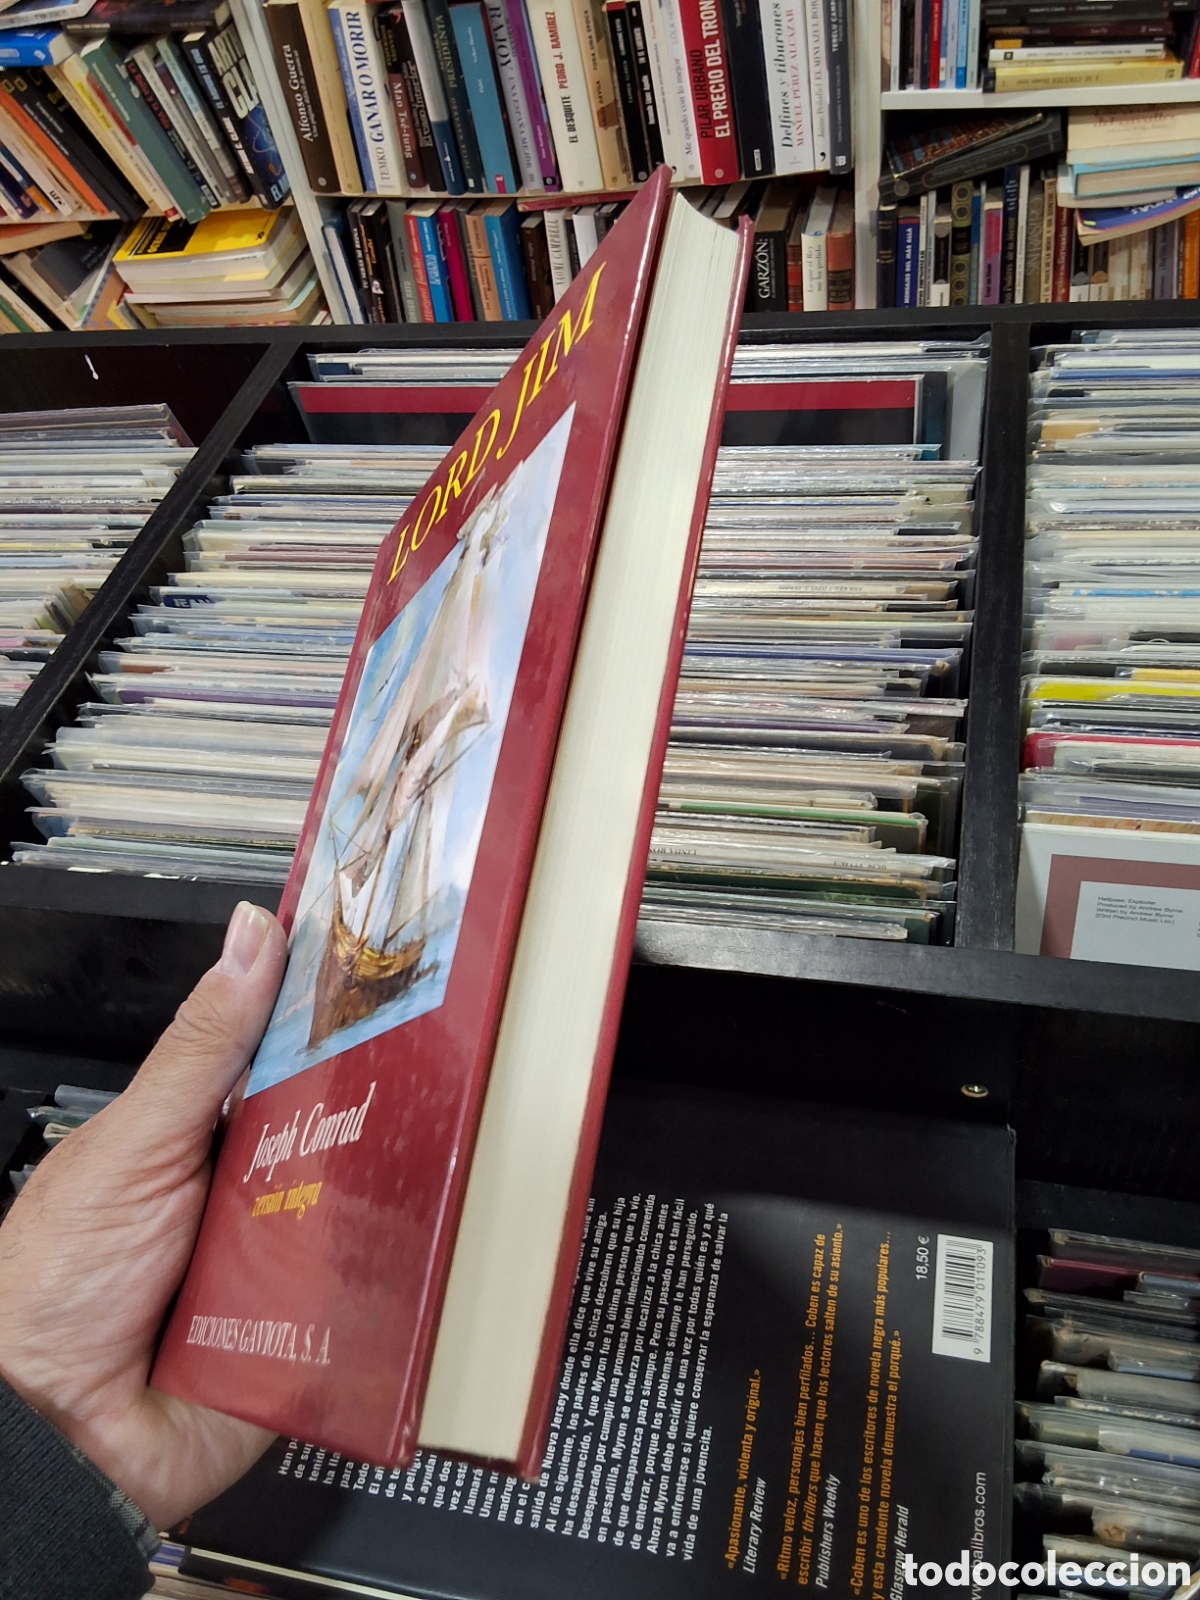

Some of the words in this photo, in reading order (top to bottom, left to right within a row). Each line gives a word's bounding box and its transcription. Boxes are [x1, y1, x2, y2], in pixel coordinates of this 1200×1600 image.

[487, 6, 511, 66] RAJOY
[545, 11, 560, 49] RAMÍREZ
[700, 0, 718, 37] TRON
[773, 3, 786, 73] tiburones
[785, 9, 797, 58] ALCÁZAR
[345, 11, 368, 69] MORIR
[435, 15, 457, 87] PRESIDENTA
[553, 52, 563, 60] J.
[705, 39, 721, 66] DEL
[282, 44, 299, 90] Guerra
[358, 74, 372, 86] O
[555, 63, 567, 88] PEDRO
[674, 58, 682, 83] mejor
[690, 49, 708, 99] URBANO
[779, 78, 789, 86] y
[790, 65, 800, 99] PÉREZ
[677, 85, 684, 94] lo
[708, 69, 728, 119] PRECIO
[294, 93, 313, 141] Alfonso
[361, 90, 384, 142] GANAR
[393, 82, 403, 107] Mao
[398, 110, 412, 157] Tsé-tung
[561, 95, 576, 132] DESQUITE
[680, 114, 692, 140] quedo
[697, 104, 713, 138] PILAR
[717, 121, 730, 137] EL
[778, 91, 794, 147] Delfines
[794, 105, 803, 146] MANUEL
[375, 146, 390, 180] TEMKO
[684, 142, 692, 154] Me
[755, 238, 770, 298] GARZÓN:
[386, 408, 501, 586] LORD
[496, 261, 607, 461] JIM
[1097, 901, 1128, 909] Produced
[243, 1109, 301, 1184] Joseph
[299, 1080, 377, 1158] Conrad
[639, 1194, 655, 1241] convertida
[681, 1210, 698, 1267] perseguido.
[814, 1234, 825, 1246] de
[918, 1236, 930, 1244] €
[624, 1243, 645, 1304] intencionada
[675, 1270, 687, 1288] han
[812, 1248, 824, 1278] capaz
[916, 1247, 930, 1280] 18,50
[976, 1248, 986, 1290] 011093
[673, 1291, 683, 1301] le
[811, 1281, 820, 1292] es
[620, 1307, 633, 1329] bien
[667, 1305, 681, 1347] siempre
[805, 1295, 818, 1327] Coben
[974, 1296, 985, 1340] 788479
[186, 1315, 241, 1350] EDICIONES
[240, 1319, 297, 1361] GAVIOTA,
[301, 1323, 316, 1364] S.
[316, 1327, 331, 1365] A.
[613, 1331, 628, 1375] promesa
[889, 1330, 902, 1378] porqué.»
[656, 1350, 674, 1409] problemas
[799, 1332, 814, 1399] perfilados…
[886, 1380, 897, 1391] el
[608, 1377, 619, 1397] una
[745, 1369, 760, 1421] original.»
[599, 1398, 615, 1440] cumplir
[650, 1412, 663, 1429] los
[745, 1423, 756, 1431] y
[794, 1402, 807, 1426] bien
[881, 1394, 896, 1455] demuestra
[595, 1442, 606, 1462] por
[645, 1432, 659, 1474] porque
[695, 1426, 712, 1485] jovencita.
[737, 1434, 752, 1479] violenta
[788, 1429, 805, 1494] personajes
[822, 1474, 840, 1518] Weekly
[880, 1458, 892, 1497] novela
[577, 1464, 602, 1538] Desesperado
[635, 1478, 653, 1530] enterrar,
[691, 1488, 702, 1510] una
[749, 1477, 765, 1521] Review
[783, 1498, 798, 1531] veloz,
[630, 1533, 641, 1549] de
[686, 1514, 698, 1529] de
[724, 1484, 747, 1568] «Apasionante,
[875, 1501, 889, 1558] candente
[682, 1534, 695, 1560] vida
[743, 1522, 762, 1573] Literary
[777, 1535, 792, 1579] «Ritmo
[815, 1521, 833, 1588] Publishers
[872, 1562, 884, 1588] esta
